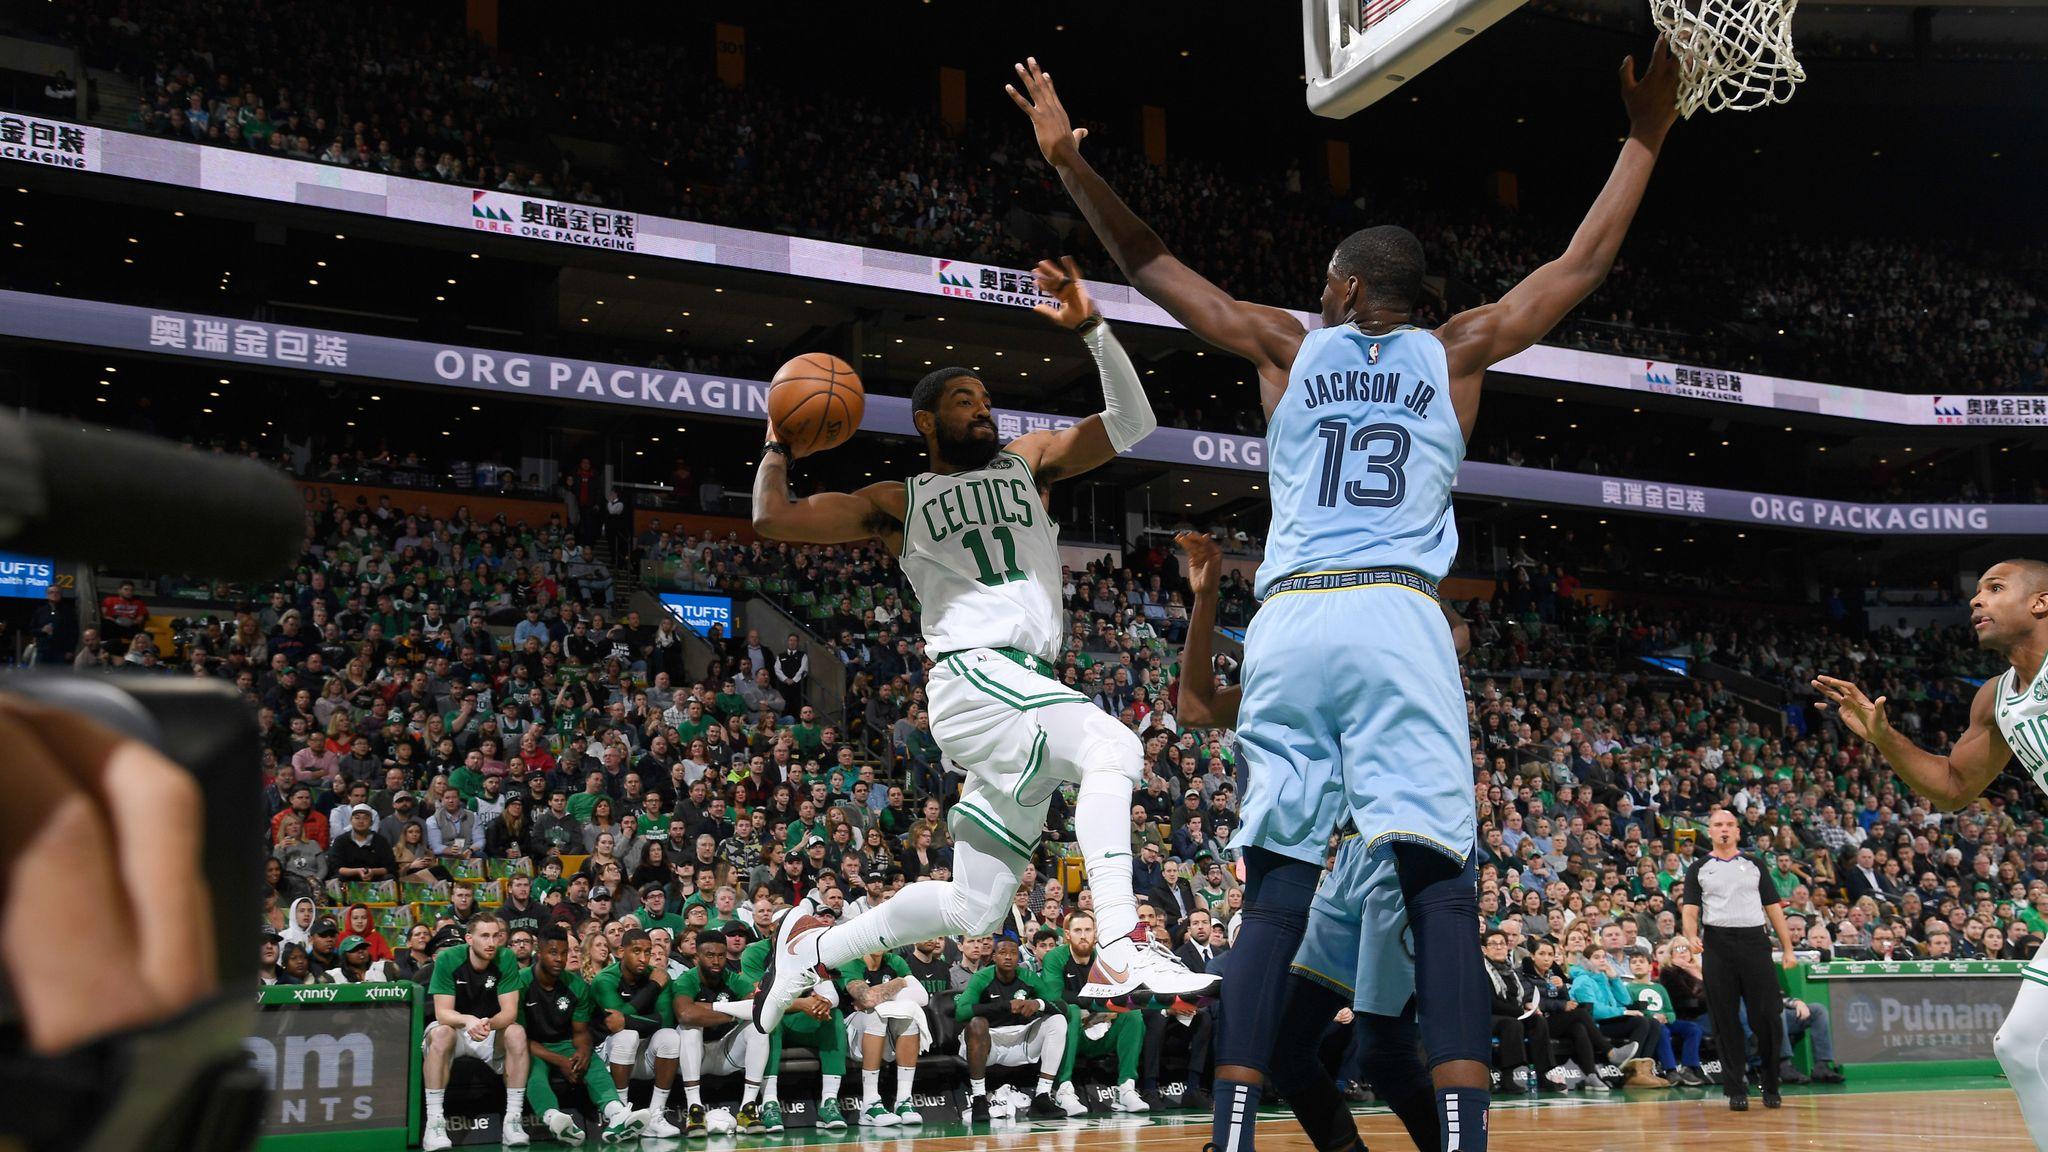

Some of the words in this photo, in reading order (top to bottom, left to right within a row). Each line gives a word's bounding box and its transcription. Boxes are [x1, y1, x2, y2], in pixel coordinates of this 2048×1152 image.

[0, 145, 86, 169] CKAGING
[520, 200, 634, 239] 奥瑞金包装
[521, 226, 550, 238] ORG
[555, 231, 635, 251] PACKAGING
[979, 290, 1004, 304] ORG
[150, 314, 348, 367] 奥瑞金包装
[434, 349, 531, 387] ORG
[1304, 370, 1401, 410] JACKSON
[1403, 379, 1437, 420] JR.
[1192, 435, 1262, 466] ORG
[1316, 420, 1412, 509] 13
[921, 477, 1034, 543] CELTICS
[1601, 480, 1706, 513] 奥瑞金包装
[1750, 496, 1804, 524] ORG
[1813, 503, 1989, 530] PACKAGING
[0, 562, 50, 577] UFTS
[961, 526, 1029, 588] 11
[684, 605, 729, 619] TUFTS
[293, 986, 339, 1002] xfinity
[365, 985, 409, 1000] xfinity
[1881, 997, 2003, 1031] Putnam
